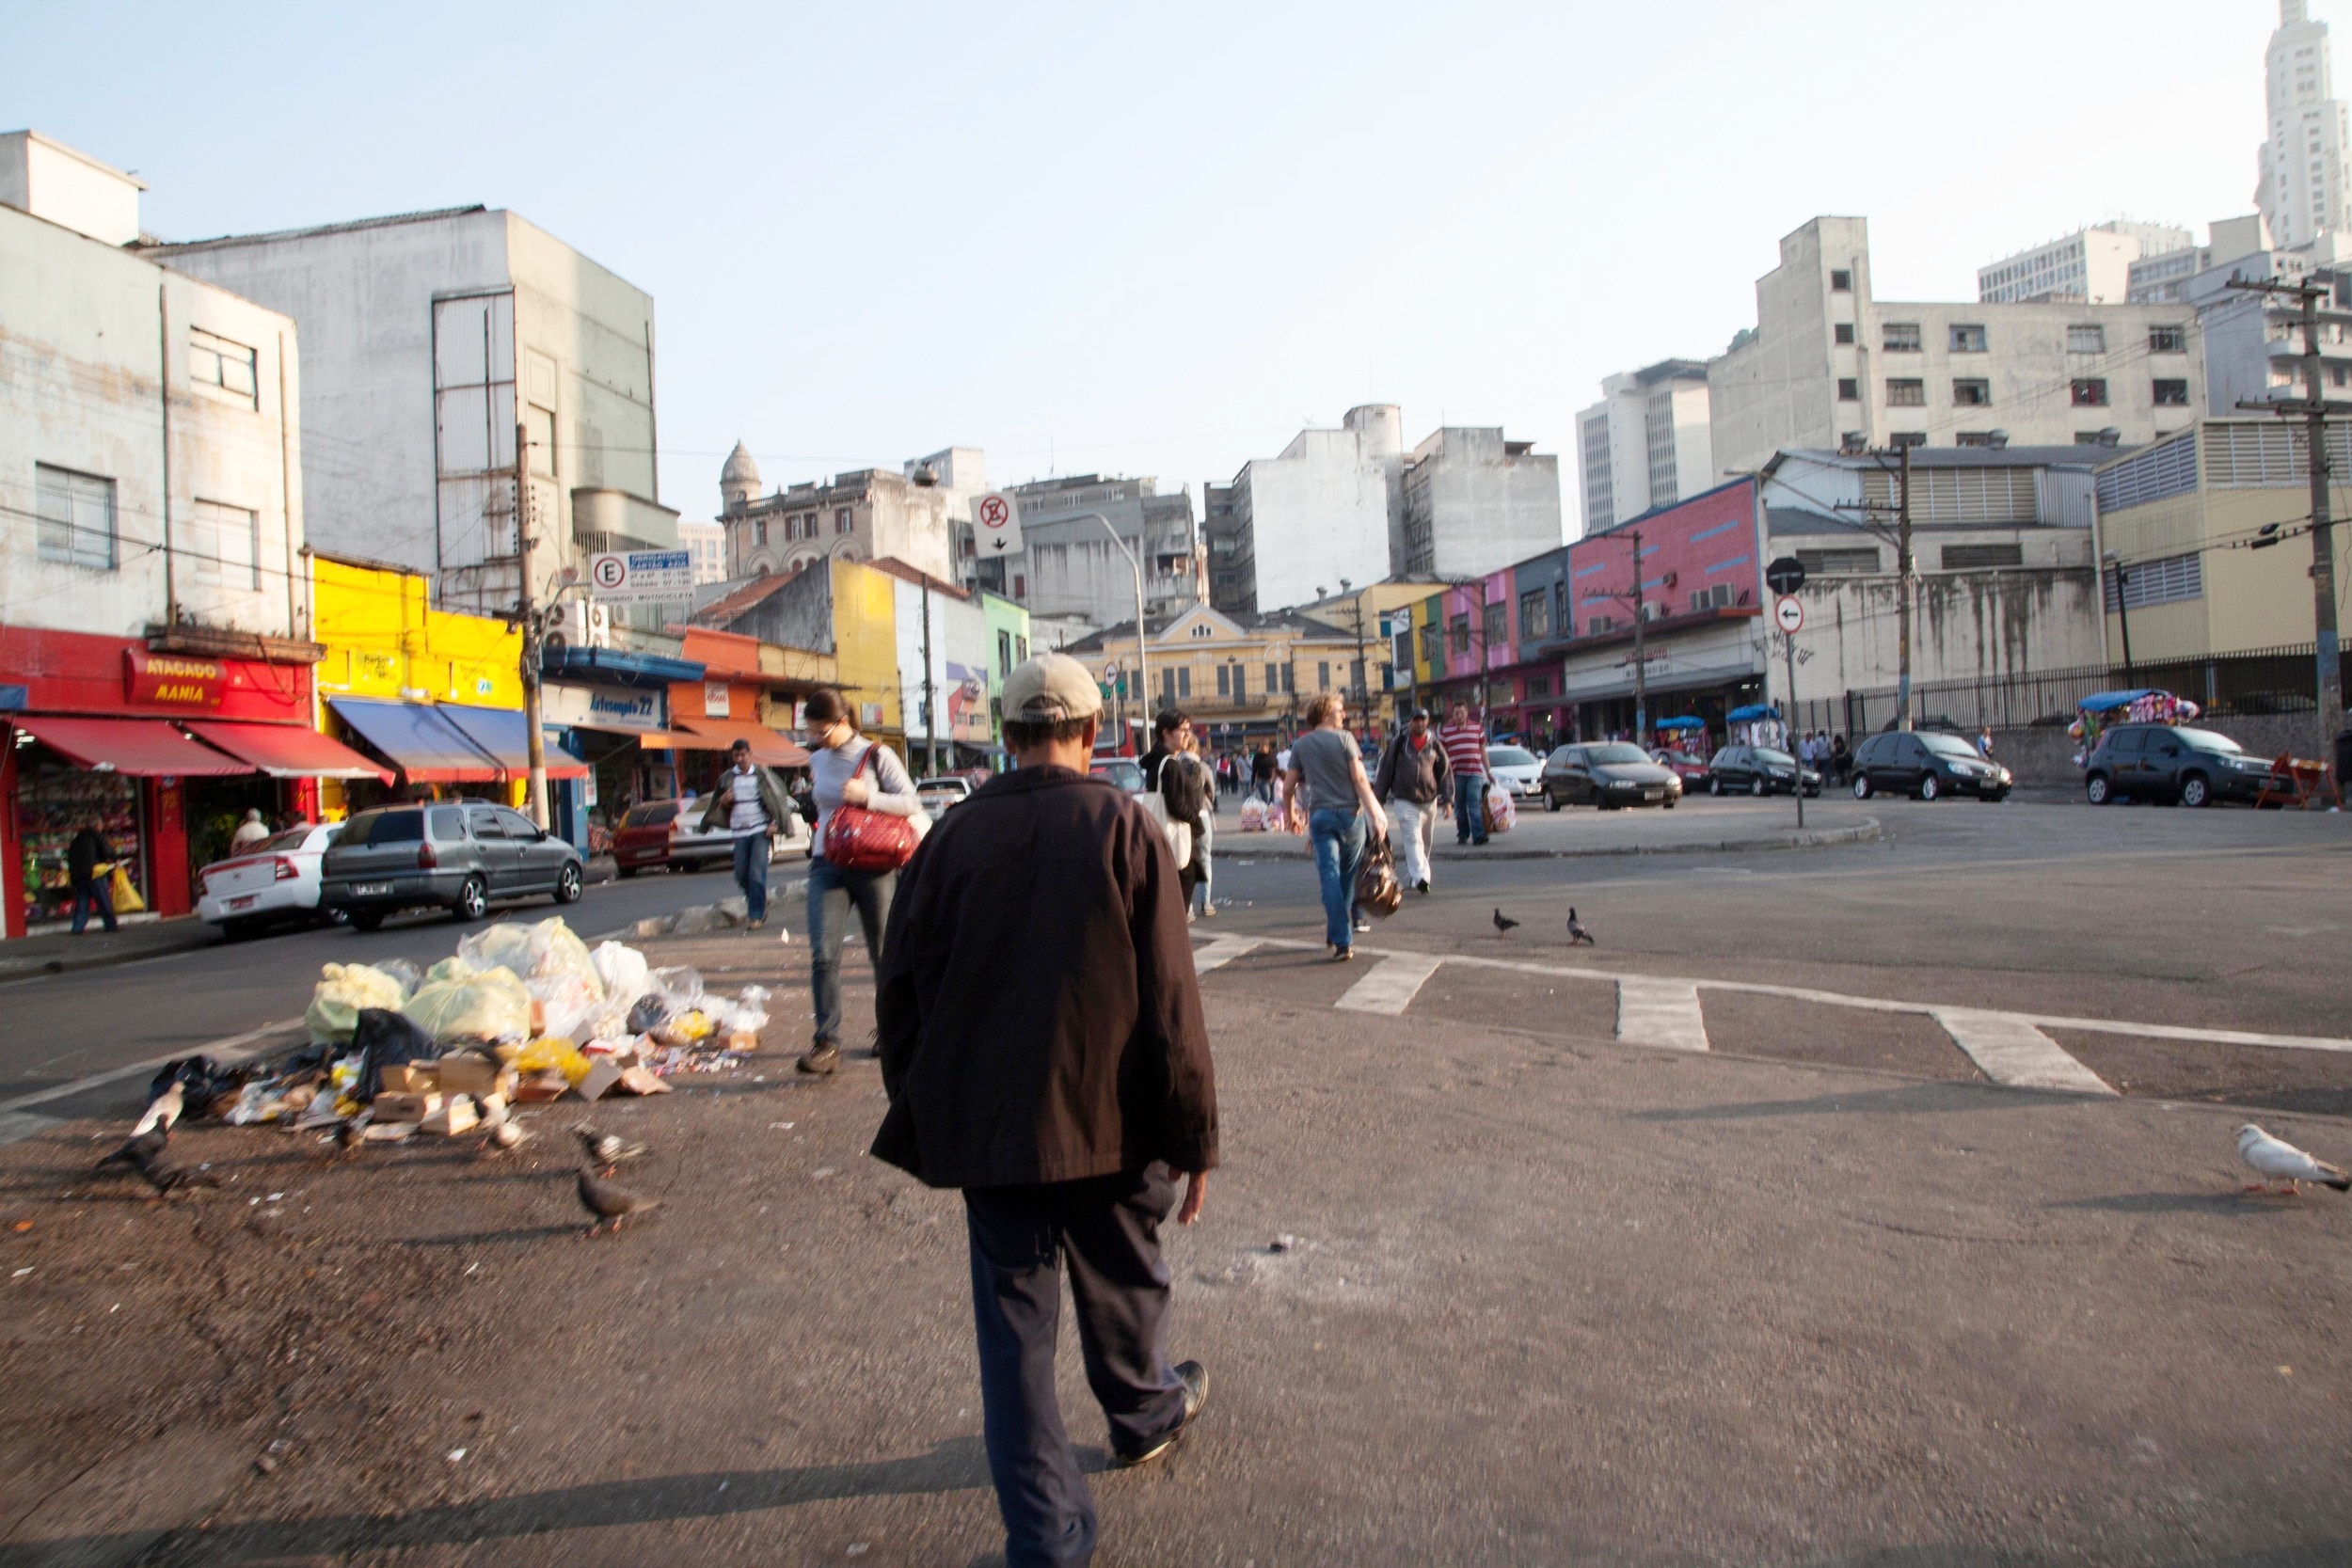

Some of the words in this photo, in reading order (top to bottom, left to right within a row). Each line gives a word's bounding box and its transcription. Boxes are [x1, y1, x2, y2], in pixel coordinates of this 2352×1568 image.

[604, 563, 616, 582] E
[595, 594, 633, 604] PROIBIDO
[638, 592, 694, 602] MOTOCICLETA
[146, 657, 216, 680] ATACADO
[154, 683, 204, 704] MANIA
[639, 695, 654, 717] 22
